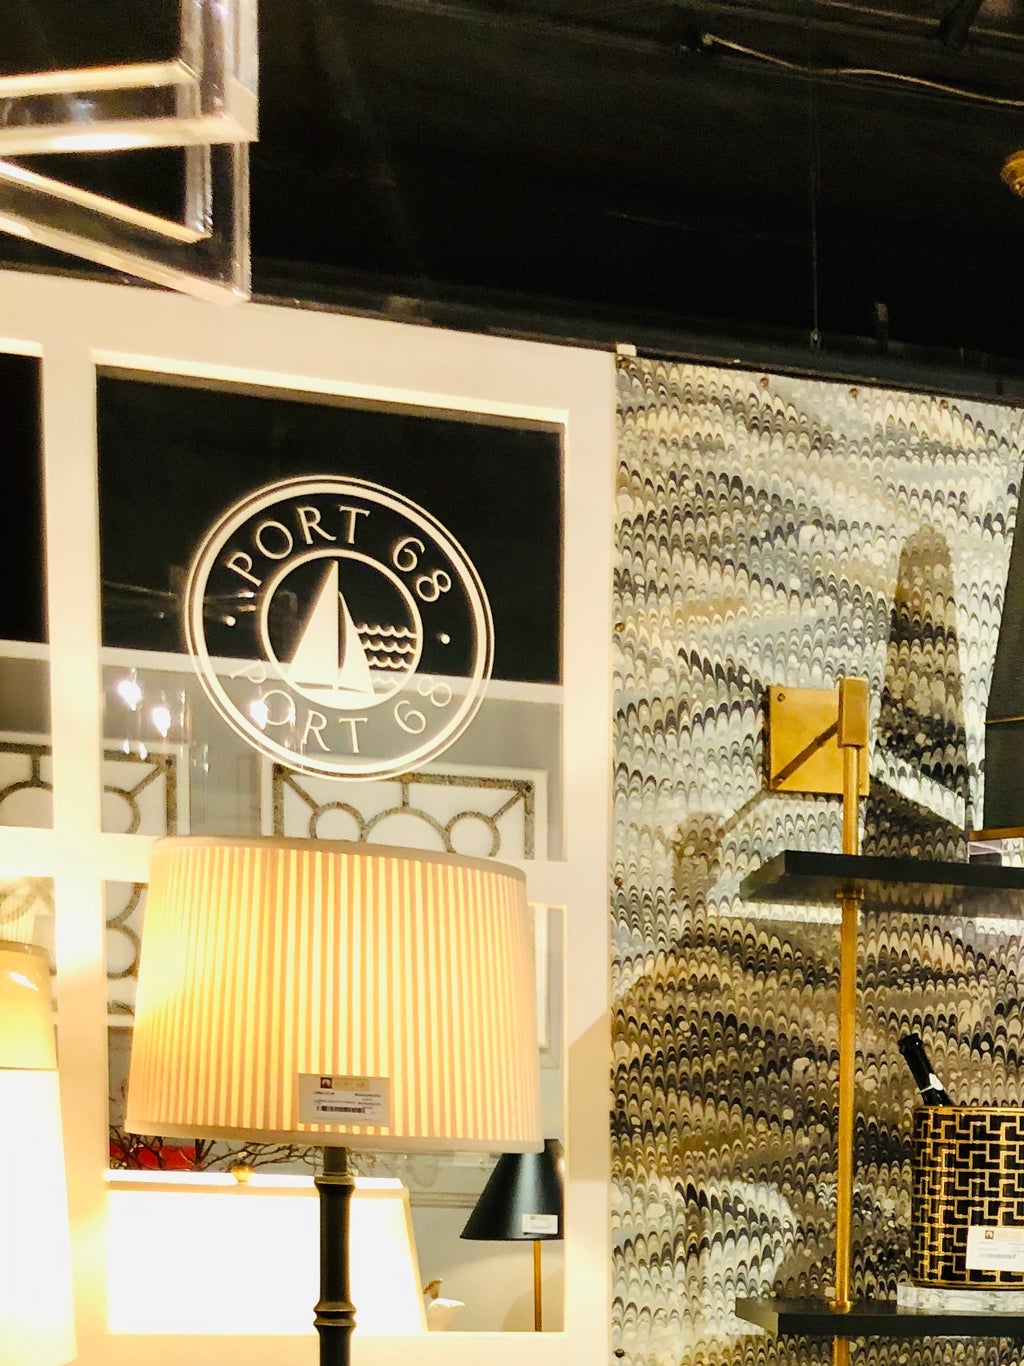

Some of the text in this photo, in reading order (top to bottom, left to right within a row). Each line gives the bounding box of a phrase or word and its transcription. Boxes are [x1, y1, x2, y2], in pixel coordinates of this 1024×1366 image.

[226, 505, 452, 603] PORT 68
[229, 659, 453, 754] PORT 68
